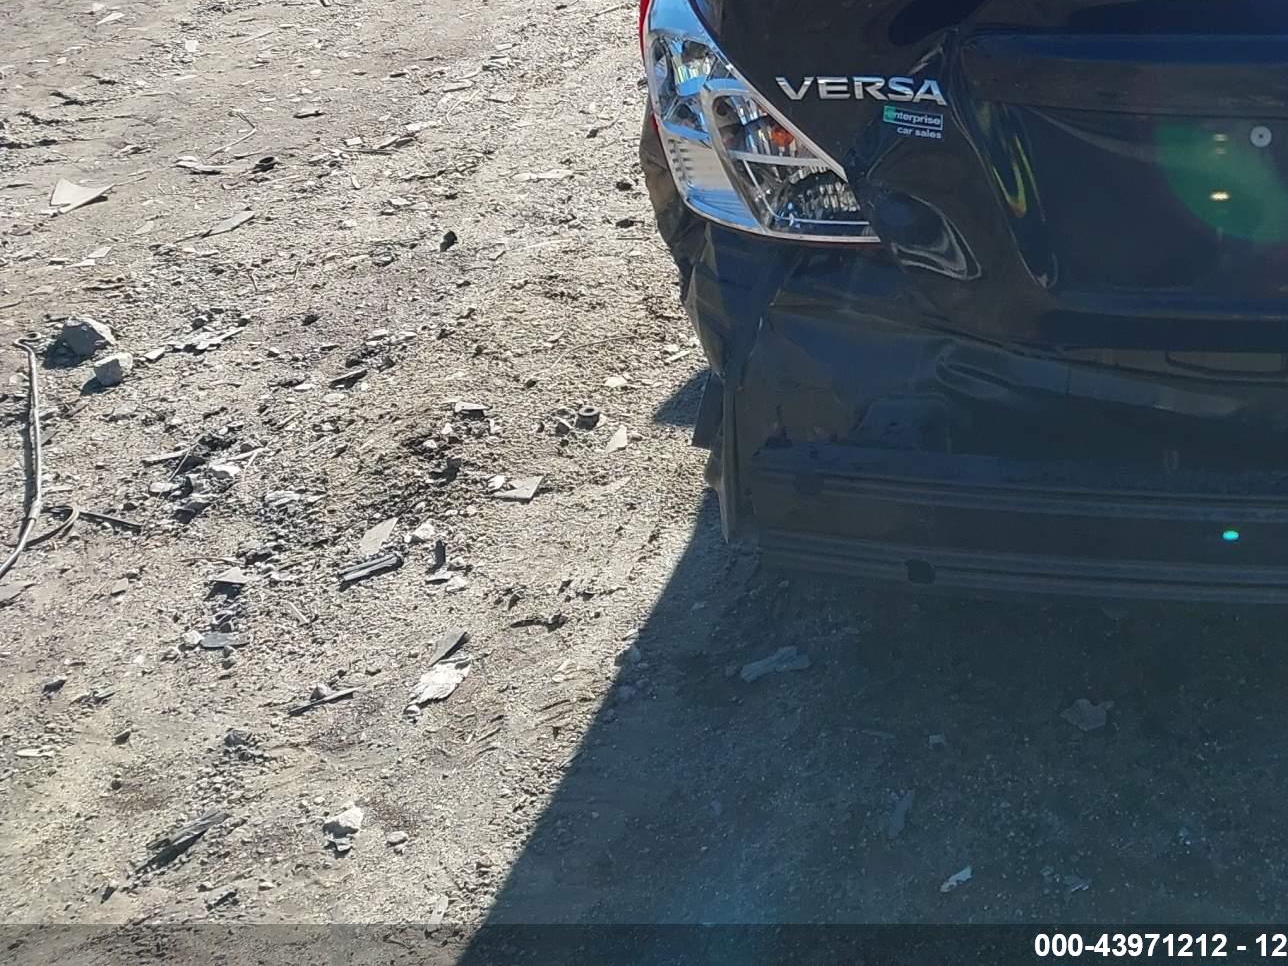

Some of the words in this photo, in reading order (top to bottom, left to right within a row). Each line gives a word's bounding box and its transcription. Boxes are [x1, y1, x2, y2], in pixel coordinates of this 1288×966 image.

[775, 76, 948, 106] VERSA
[886, 109, 941, 126] enterprise
[896, 126, 913, 136] car
[914, 128, 942, 139] sales
